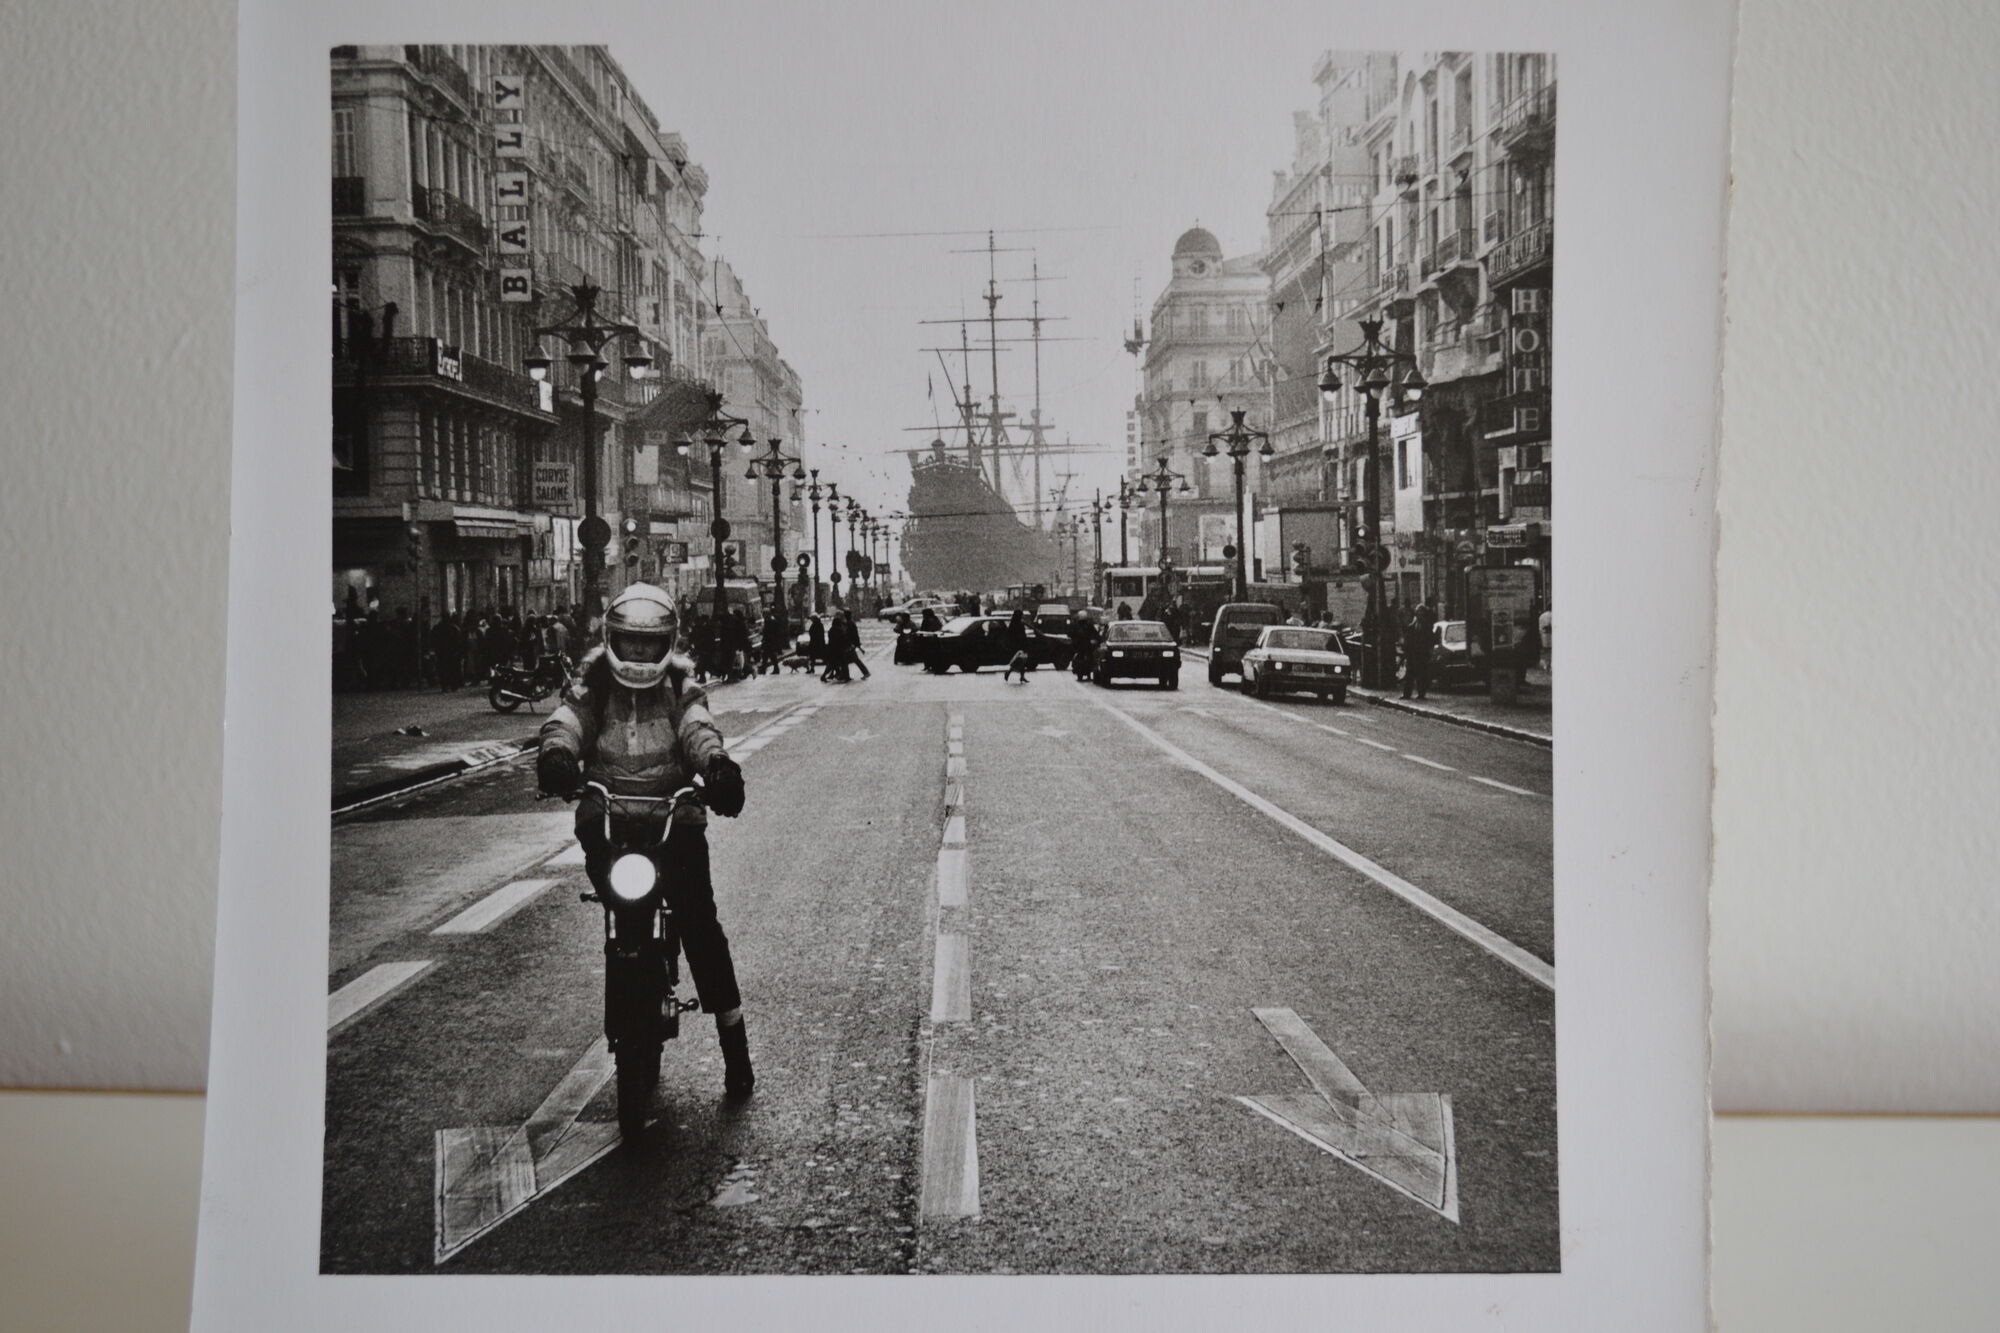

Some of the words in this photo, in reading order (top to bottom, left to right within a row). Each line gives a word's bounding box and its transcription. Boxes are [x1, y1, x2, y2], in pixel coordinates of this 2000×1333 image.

[495, 79, 529, 295] BALLY
[1515, 288, 1541, 471] HOTEL
[535, 468, 570, 483] CORYSE
